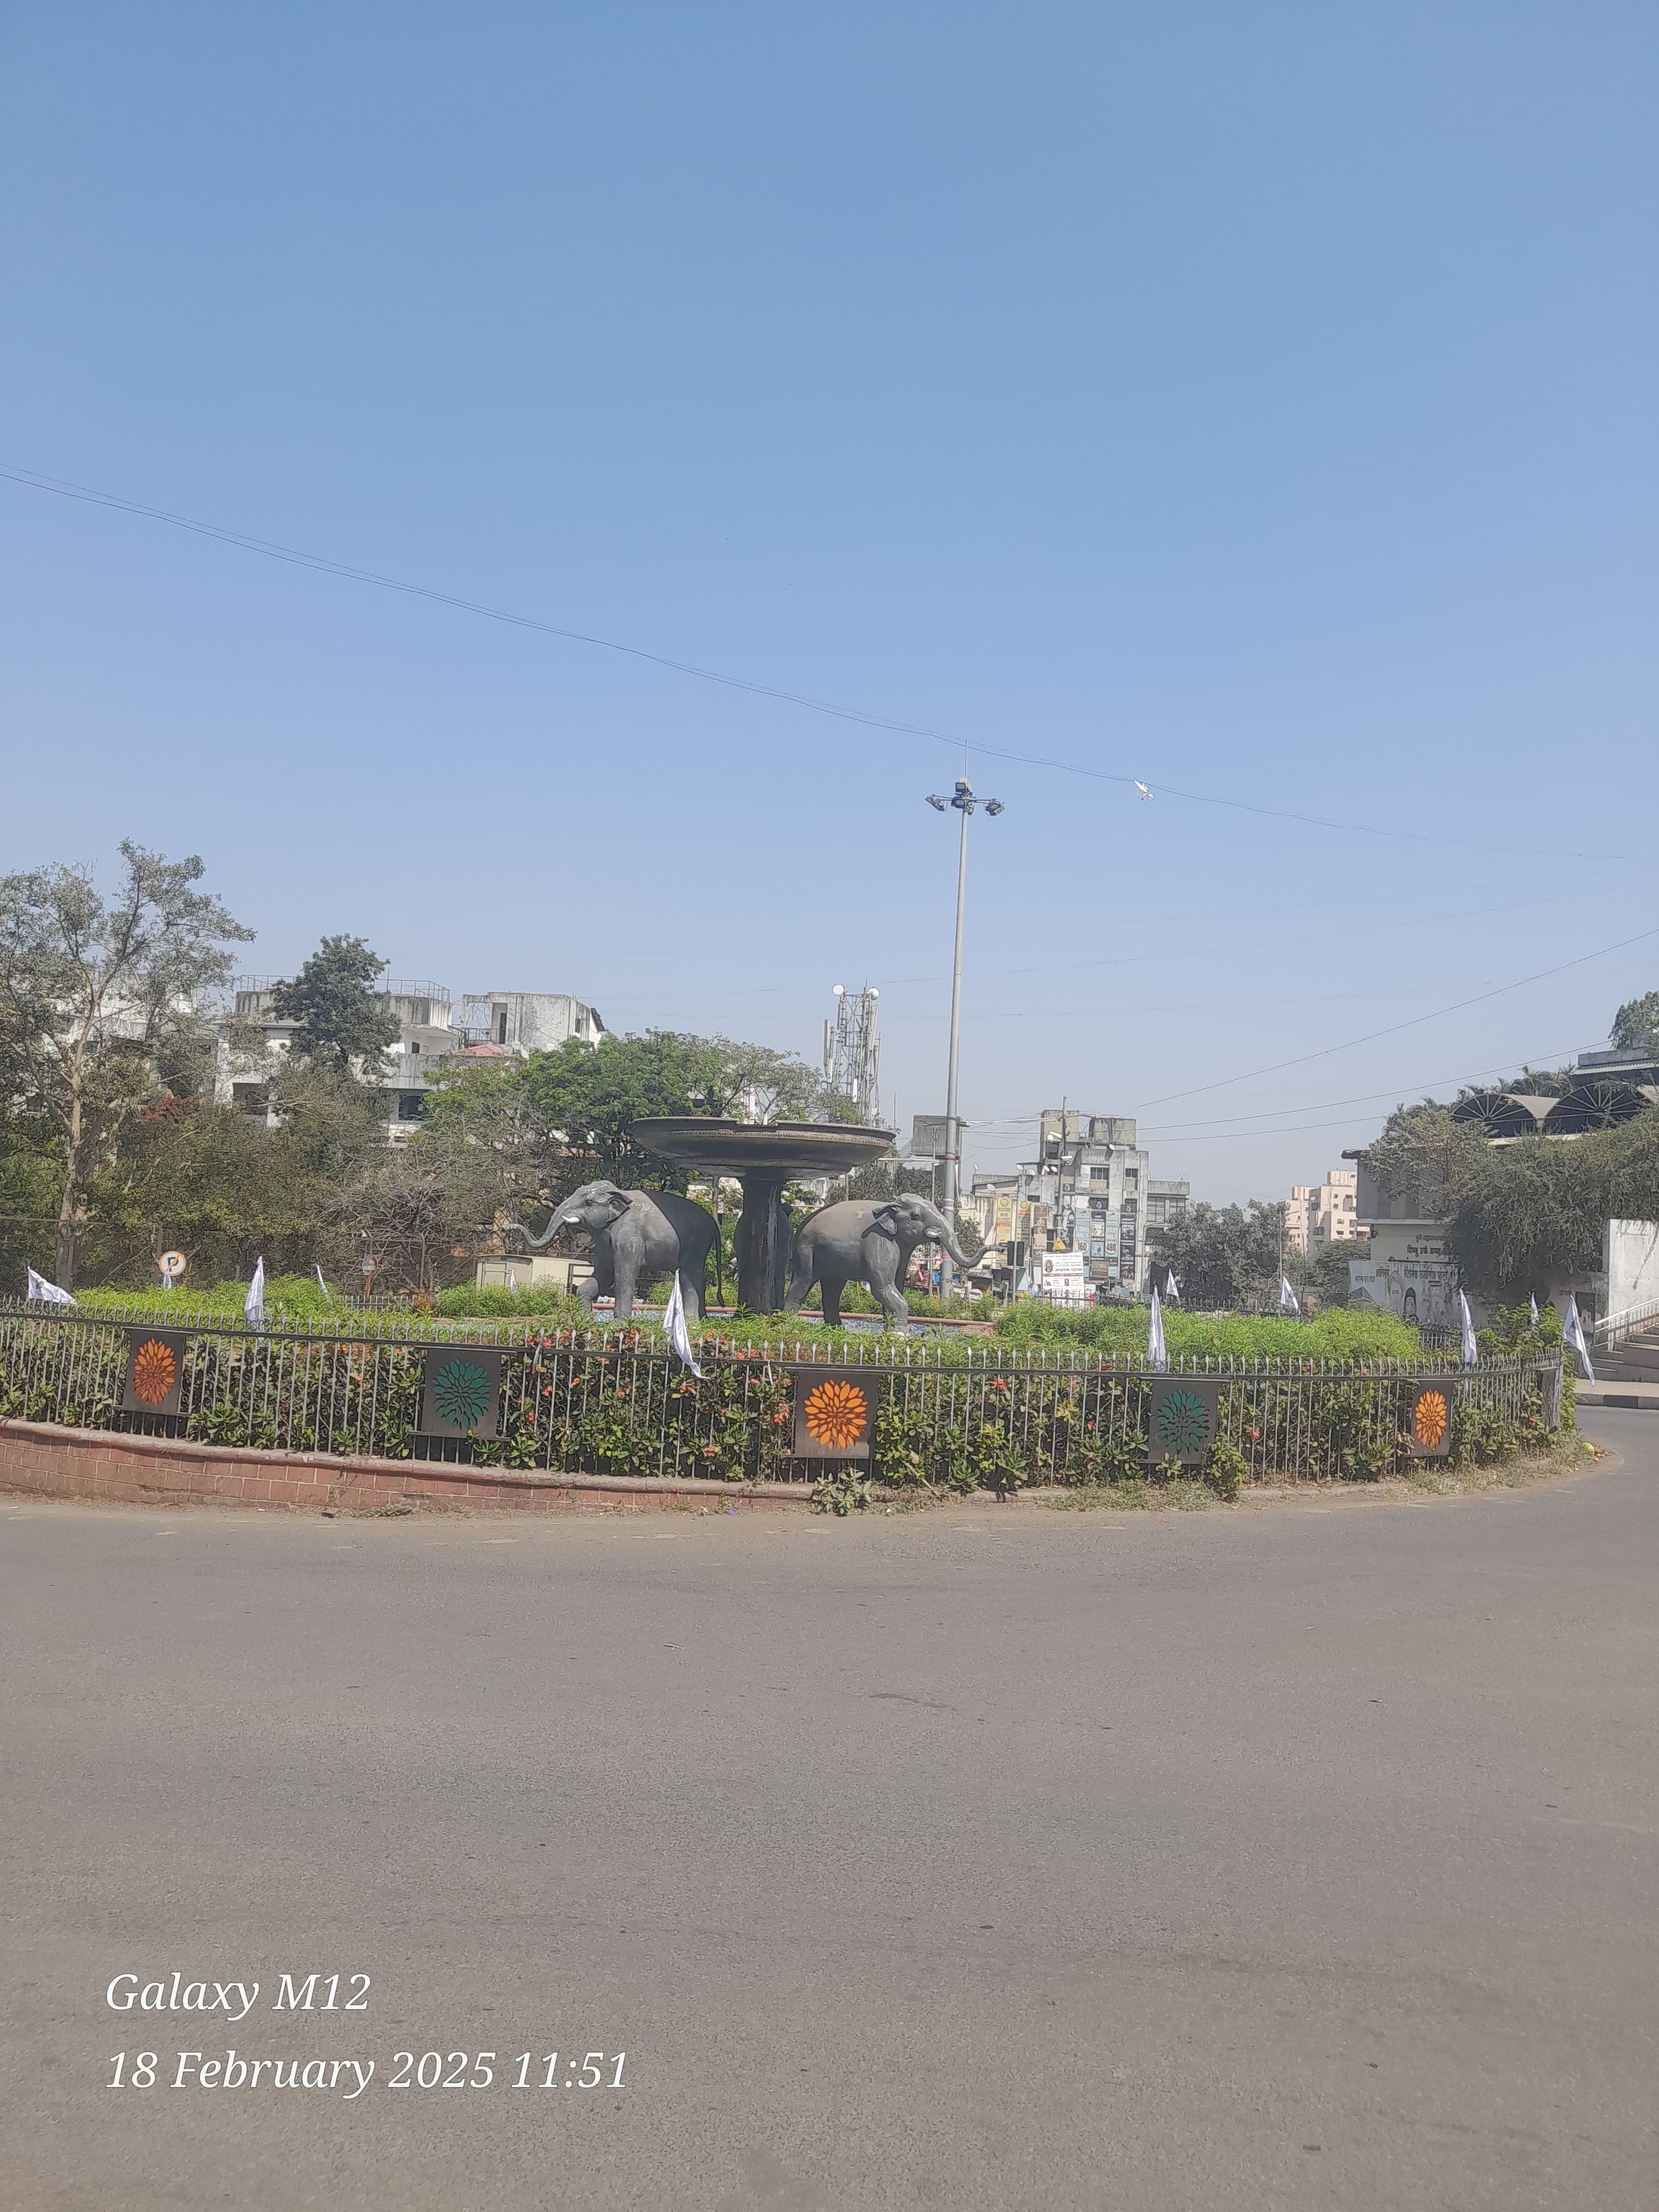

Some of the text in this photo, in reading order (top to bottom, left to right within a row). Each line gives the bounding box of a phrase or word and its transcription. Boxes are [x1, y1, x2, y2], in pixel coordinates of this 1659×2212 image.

[1077, 1242, 1087, 1251] 160
[1106, 1243, 1117, 1251] 480
[1420, 1245, 1428, 1254] उर्फ
[167, 1256, 179, 1272] P
